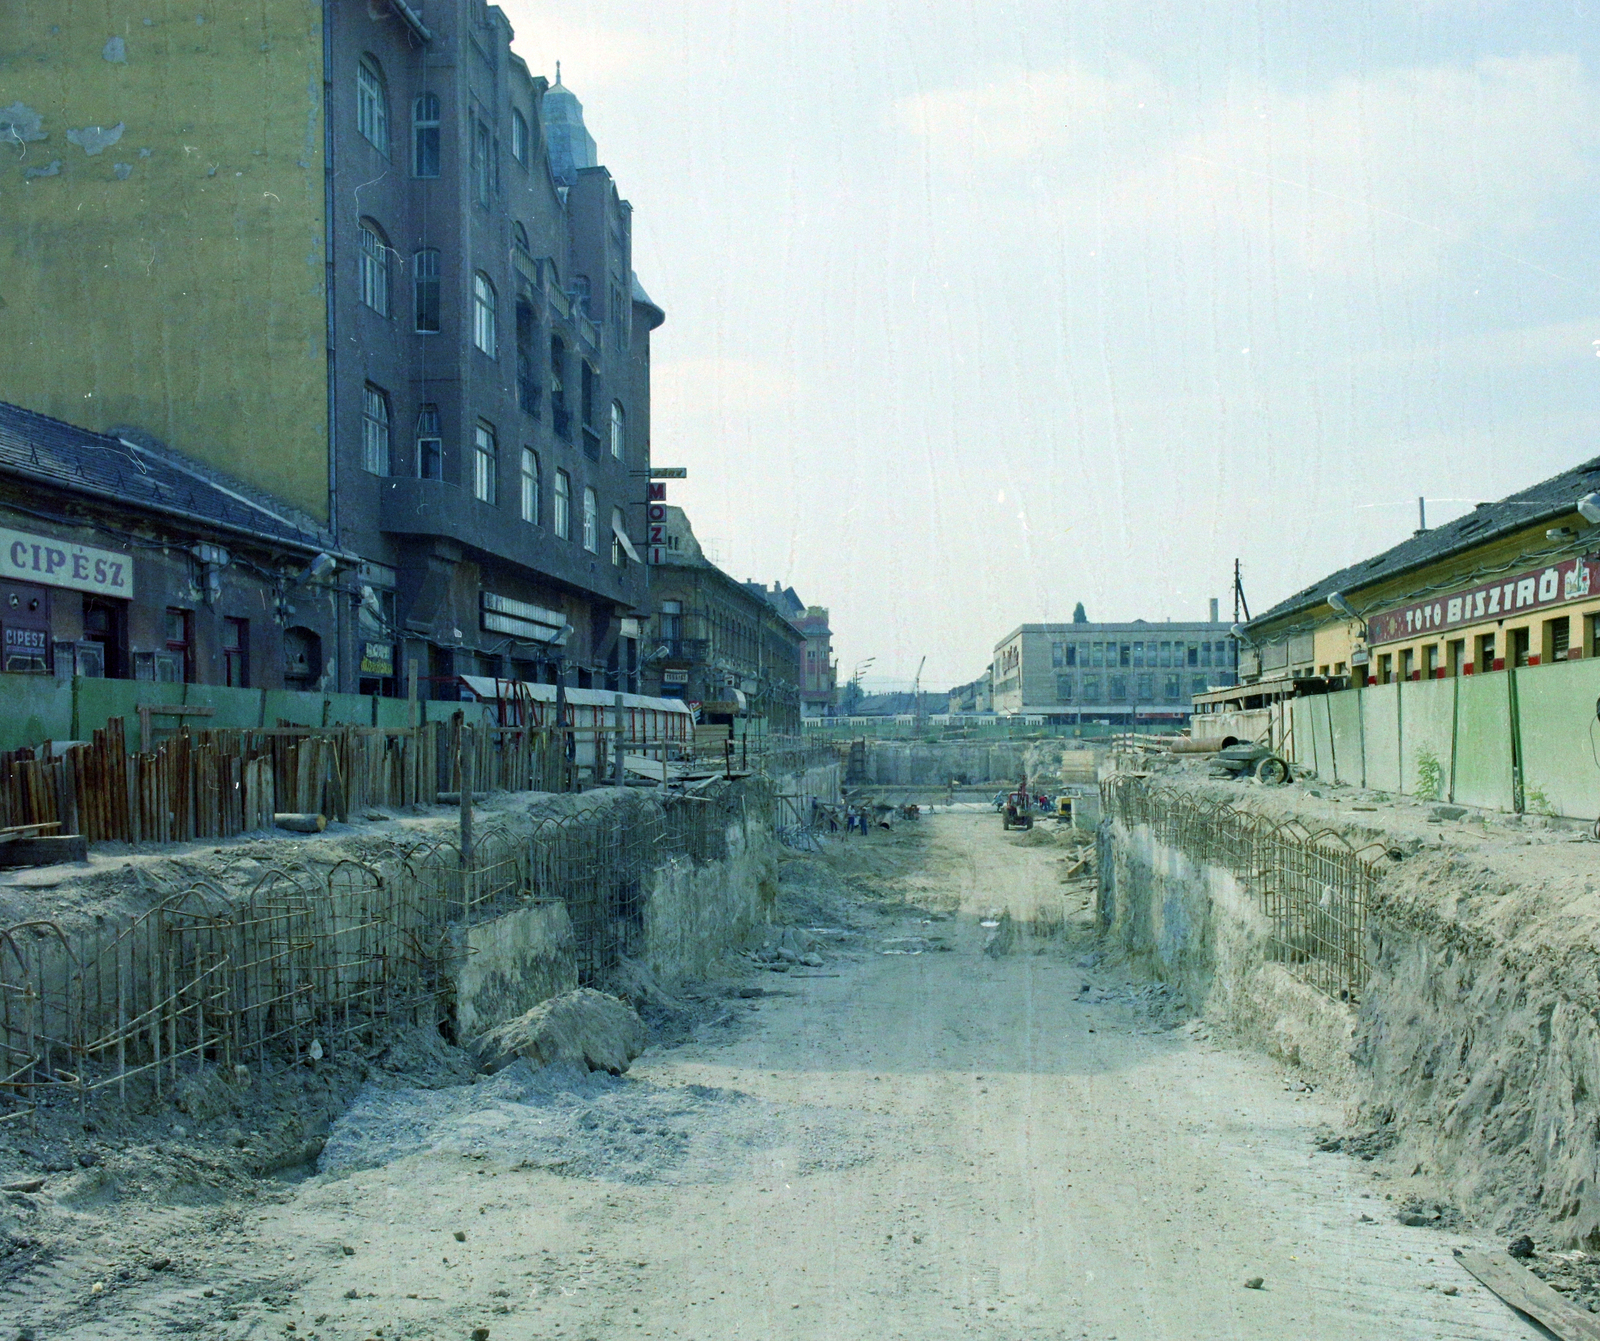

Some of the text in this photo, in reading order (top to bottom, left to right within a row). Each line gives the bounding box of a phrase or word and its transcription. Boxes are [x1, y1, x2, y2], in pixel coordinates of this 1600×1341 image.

[649, 484, 664, 563] MOZI
[10, 541, 125, 588] CIPÉSZ
[1406, 603, 1442, 632] TOTO
